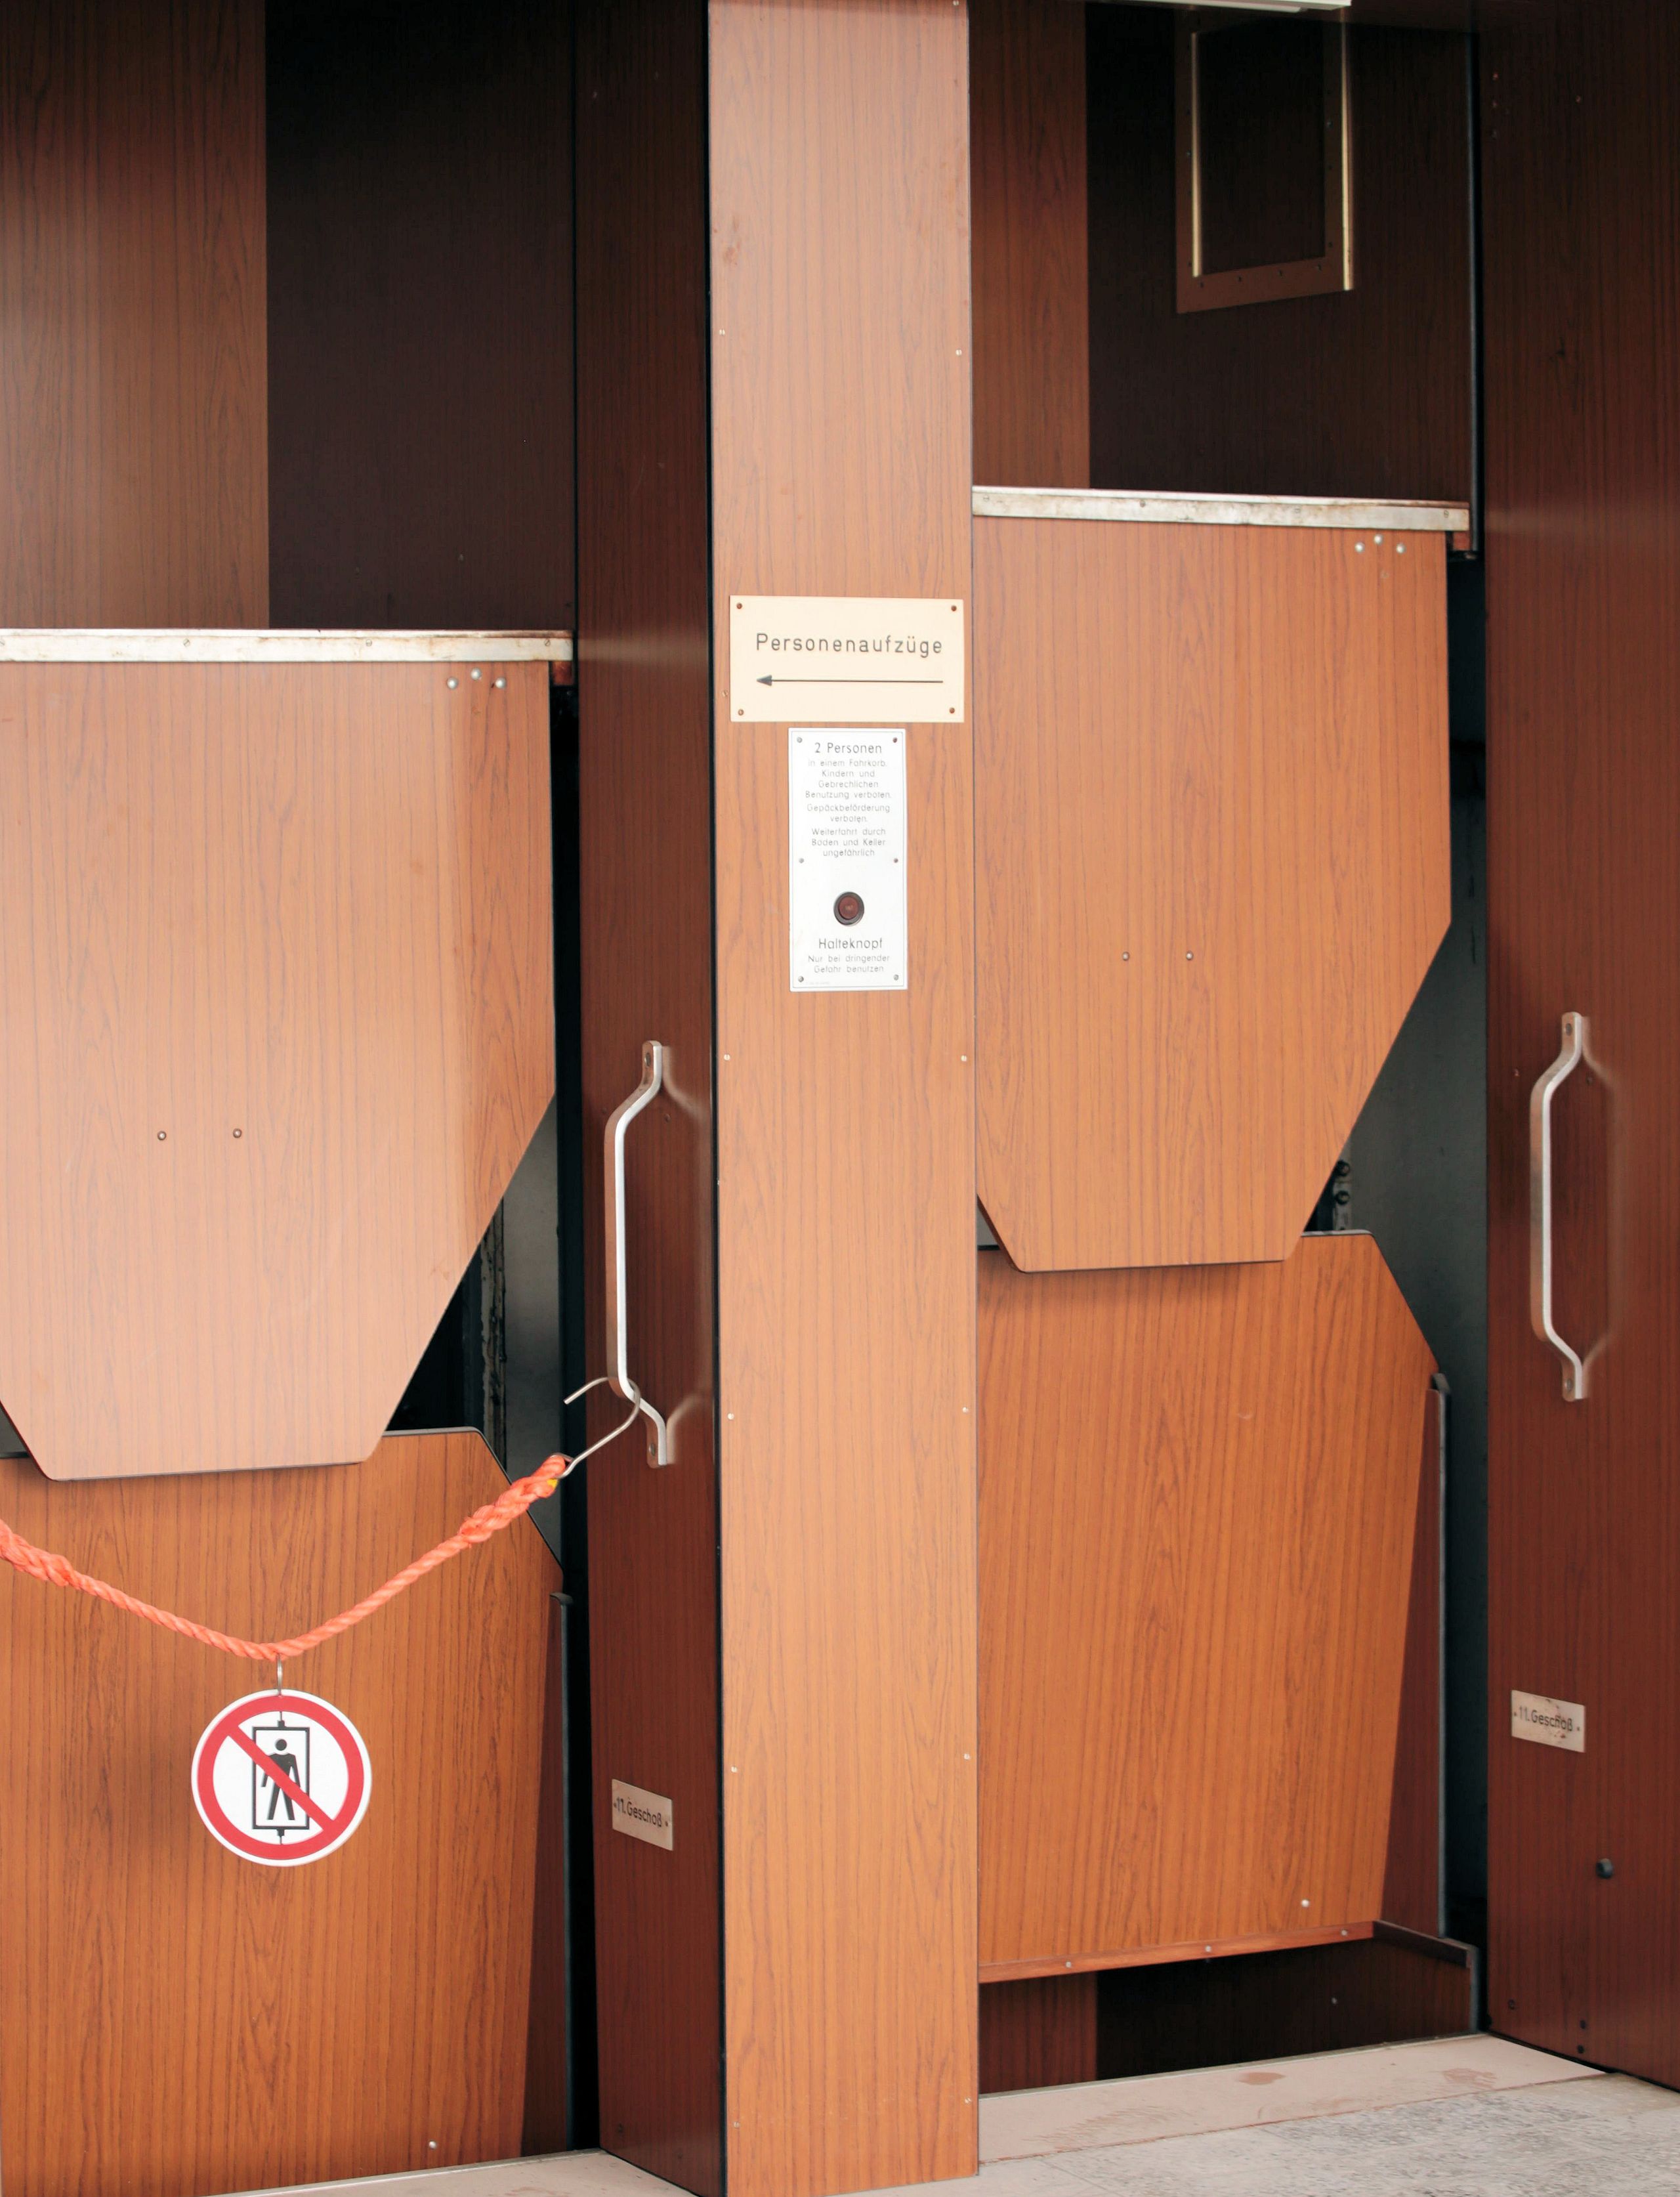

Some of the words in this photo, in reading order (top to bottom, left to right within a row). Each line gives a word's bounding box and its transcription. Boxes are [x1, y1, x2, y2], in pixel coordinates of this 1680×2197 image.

[756, 632, 942, 658] Personenaufzüge
[814, 742, 821, 753] 2
[827, 742, 882, 754] Personen
[805, 790, 849, 800] Benutzung
[819, 937, 882, 950] Halteknopf
[845, 954, 890, 963] dringender
